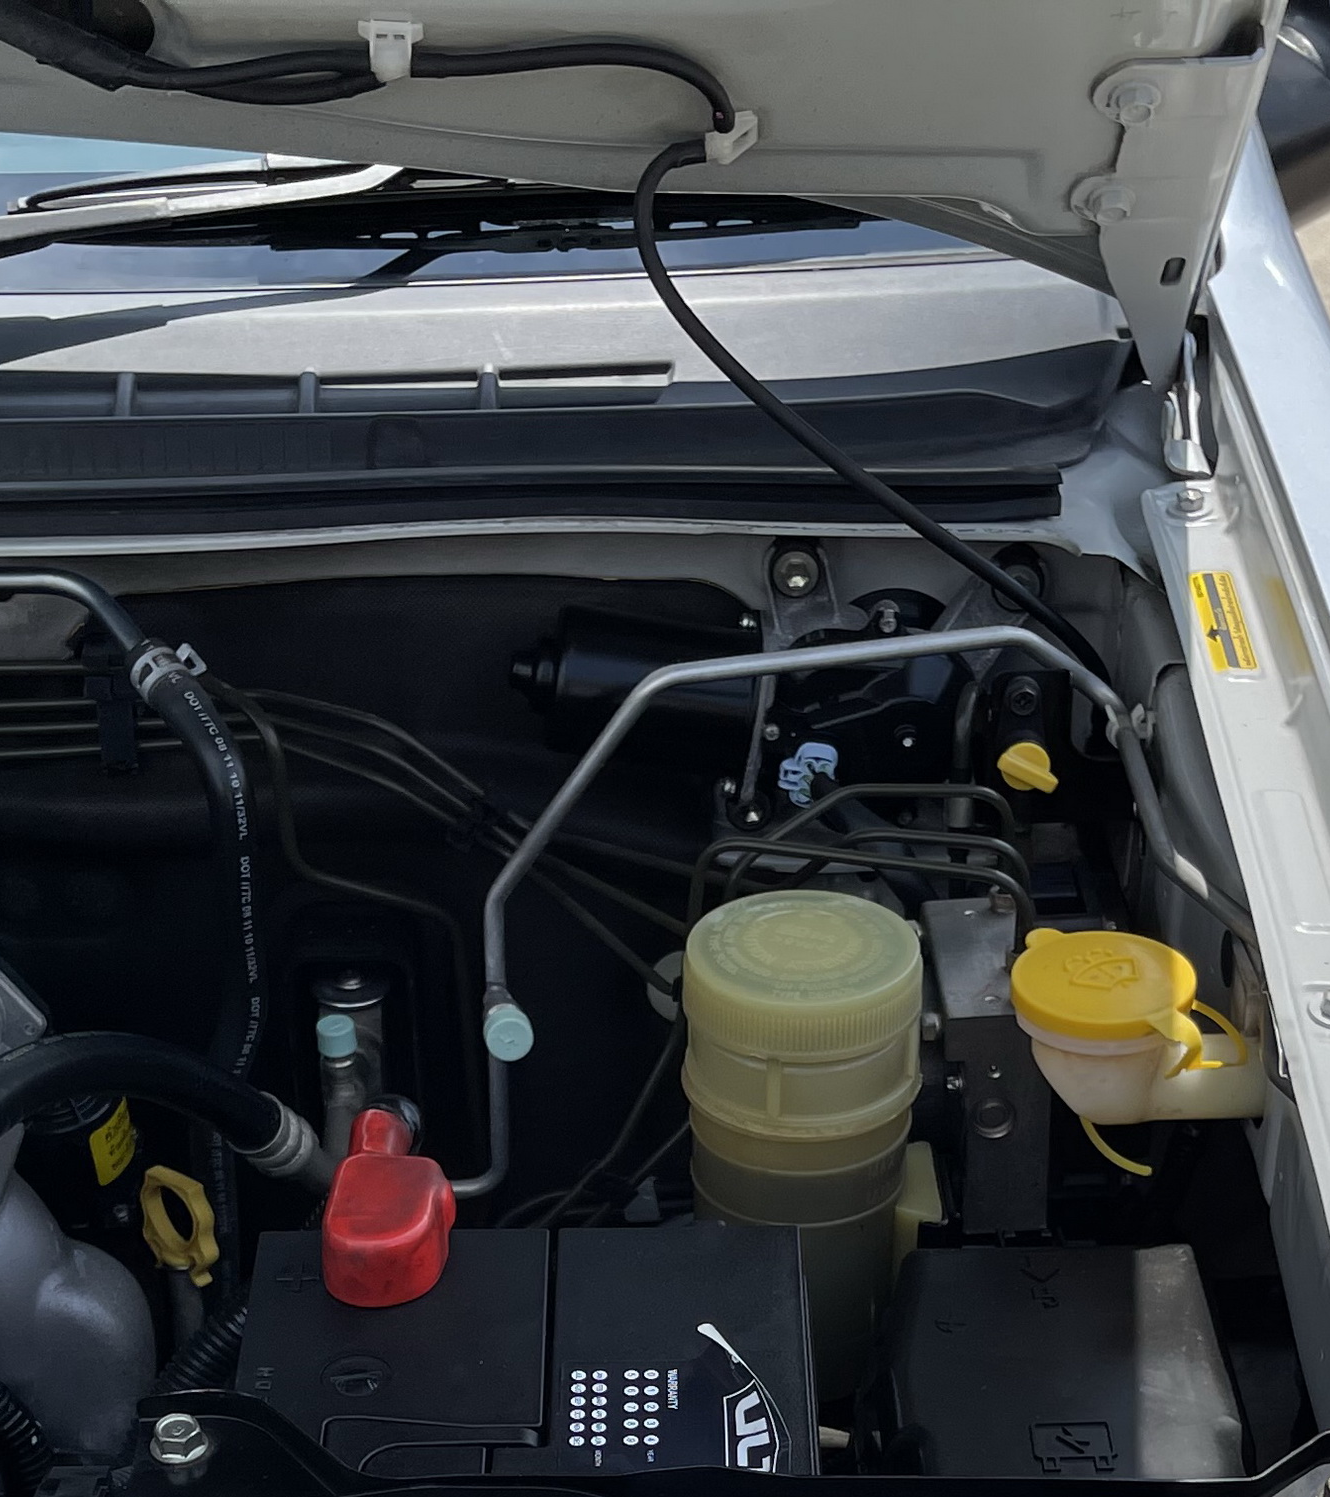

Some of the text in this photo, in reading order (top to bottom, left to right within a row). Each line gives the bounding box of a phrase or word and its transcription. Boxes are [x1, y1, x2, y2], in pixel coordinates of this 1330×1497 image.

[183, 691, 202, 711] DOT
[239, 856, 251, 878] DOT
[250, 996, 261, 1018] DOT
[667, 1369, 679, 1410] WARRANTY
